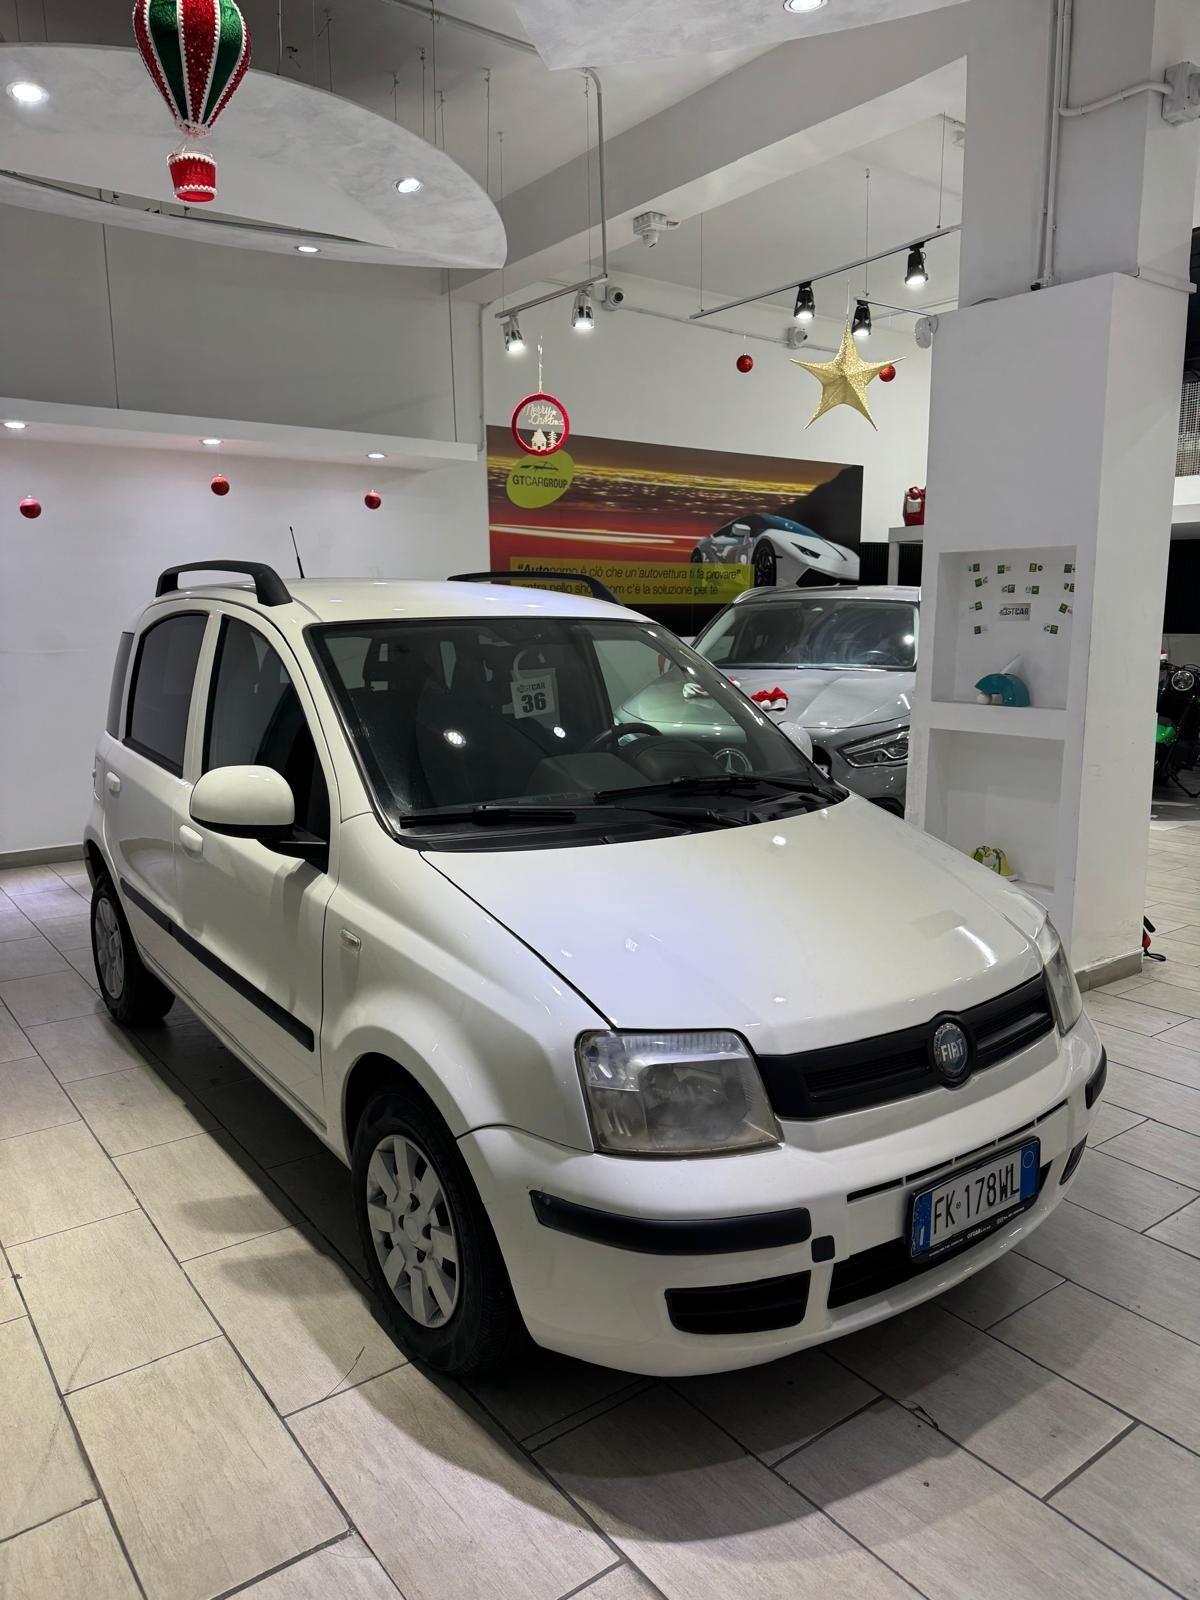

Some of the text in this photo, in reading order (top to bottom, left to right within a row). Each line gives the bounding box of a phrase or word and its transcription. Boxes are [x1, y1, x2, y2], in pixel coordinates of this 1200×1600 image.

[512, 475, 568, 489] GTCARGROUP
[589, 565, 604, 578] ciò
[605, 566, 623, 578] che
[643, 584, 650, 594] la
[652, 584, 692, 595] soluzione
[694, 586, 707, 597] per
[521, 692, 546, 713] 36
[940, 1038, 964, 1062] FIAT
